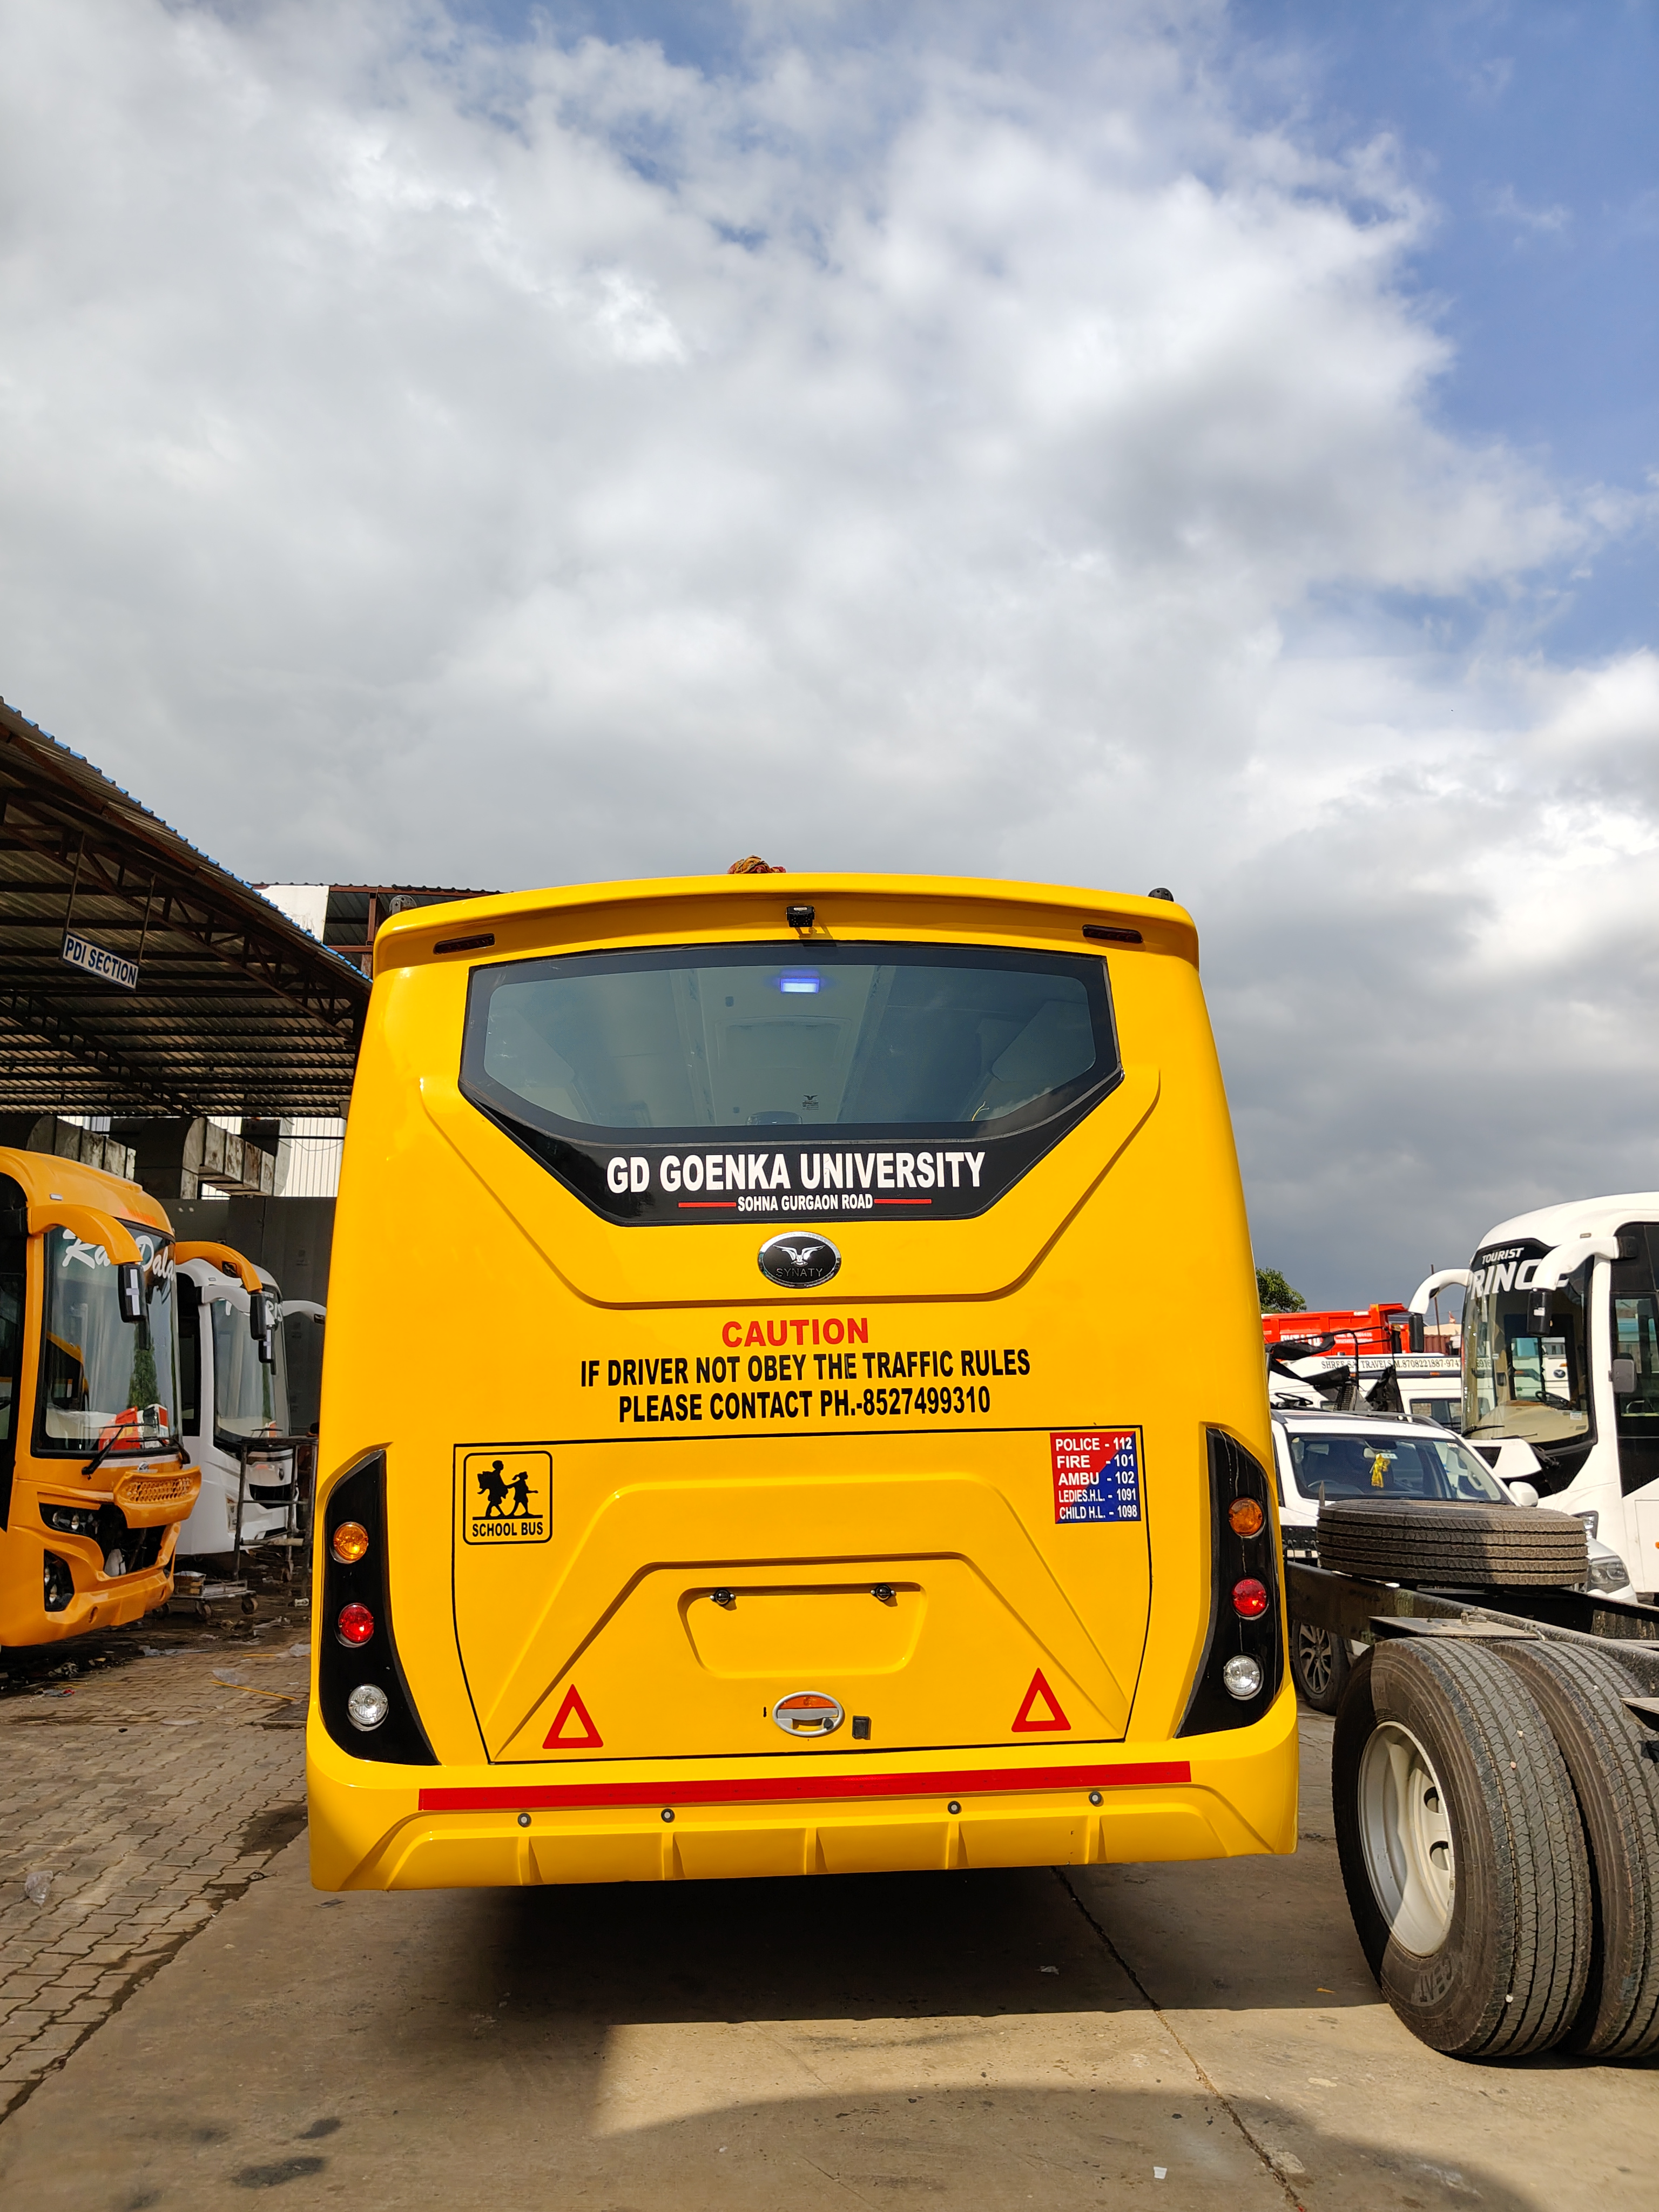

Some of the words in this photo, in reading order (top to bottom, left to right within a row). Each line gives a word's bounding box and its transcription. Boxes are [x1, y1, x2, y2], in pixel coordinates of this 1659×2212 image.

[65, 938, 86, 963] PDI
[88, 949, 136, 986] SECTION
[607, 1157, 650, 1193] GD
[660, 1154, 791, 1191] GOENKA
[800, 1152, 986, 1189] UNIVERSITY
[738, 1196, 778, 1211] SOHNA
[781, 1194, 838, 1210] GURGAON
[842, 1193, 873, 1209] ROAD
[1482, 1247, 1525, 1265] TOURIST
[776, 1268, 822, 1277] SYNATY
[722, 1318, 868, 1347] CAUTION
[581, 1360, 600, 1387] IF
[608, 1358, 689, 1386] DRIVER
[696, 1356, 740, 1384] NOT
[748, 1354, 807, 1382] OBEY
[813, 1353, 857, 1380] THE
[862, 1350, 954, 1379] TRAFFIC
[961, 1348, 1030, 1377] RULES
[1360, 1360, 1392, 1369] TRAVELS
[619, 1393, 702, 1422] PLEASE
[710, 1390, 812, 1420] CONTACT
[820, 1386, 990, 1417] PH.-8527499310
[1056, 1438, 1100, 1451] POLICE
[1114, 1437, 1132, 1450] 112
[1057, 1455, 1090, 1468] FIRE
[1114, 1454, 1134, 1467] 101
[1058, 1472, 1100, 1486] AMBU
[1115, 1471, 1135, 1484] 102
[1117, 1488, 1136, 1501] 1091
[1060, 1506, 1087, 1519] CHILD
[1089, 1506, 1105, 1518] H.L.
[1117, 1505, 1137, 1518] 1098
[472, 1522, 517, 1537] SCHOOL
[521, 1521, 543, 1535] BUS
